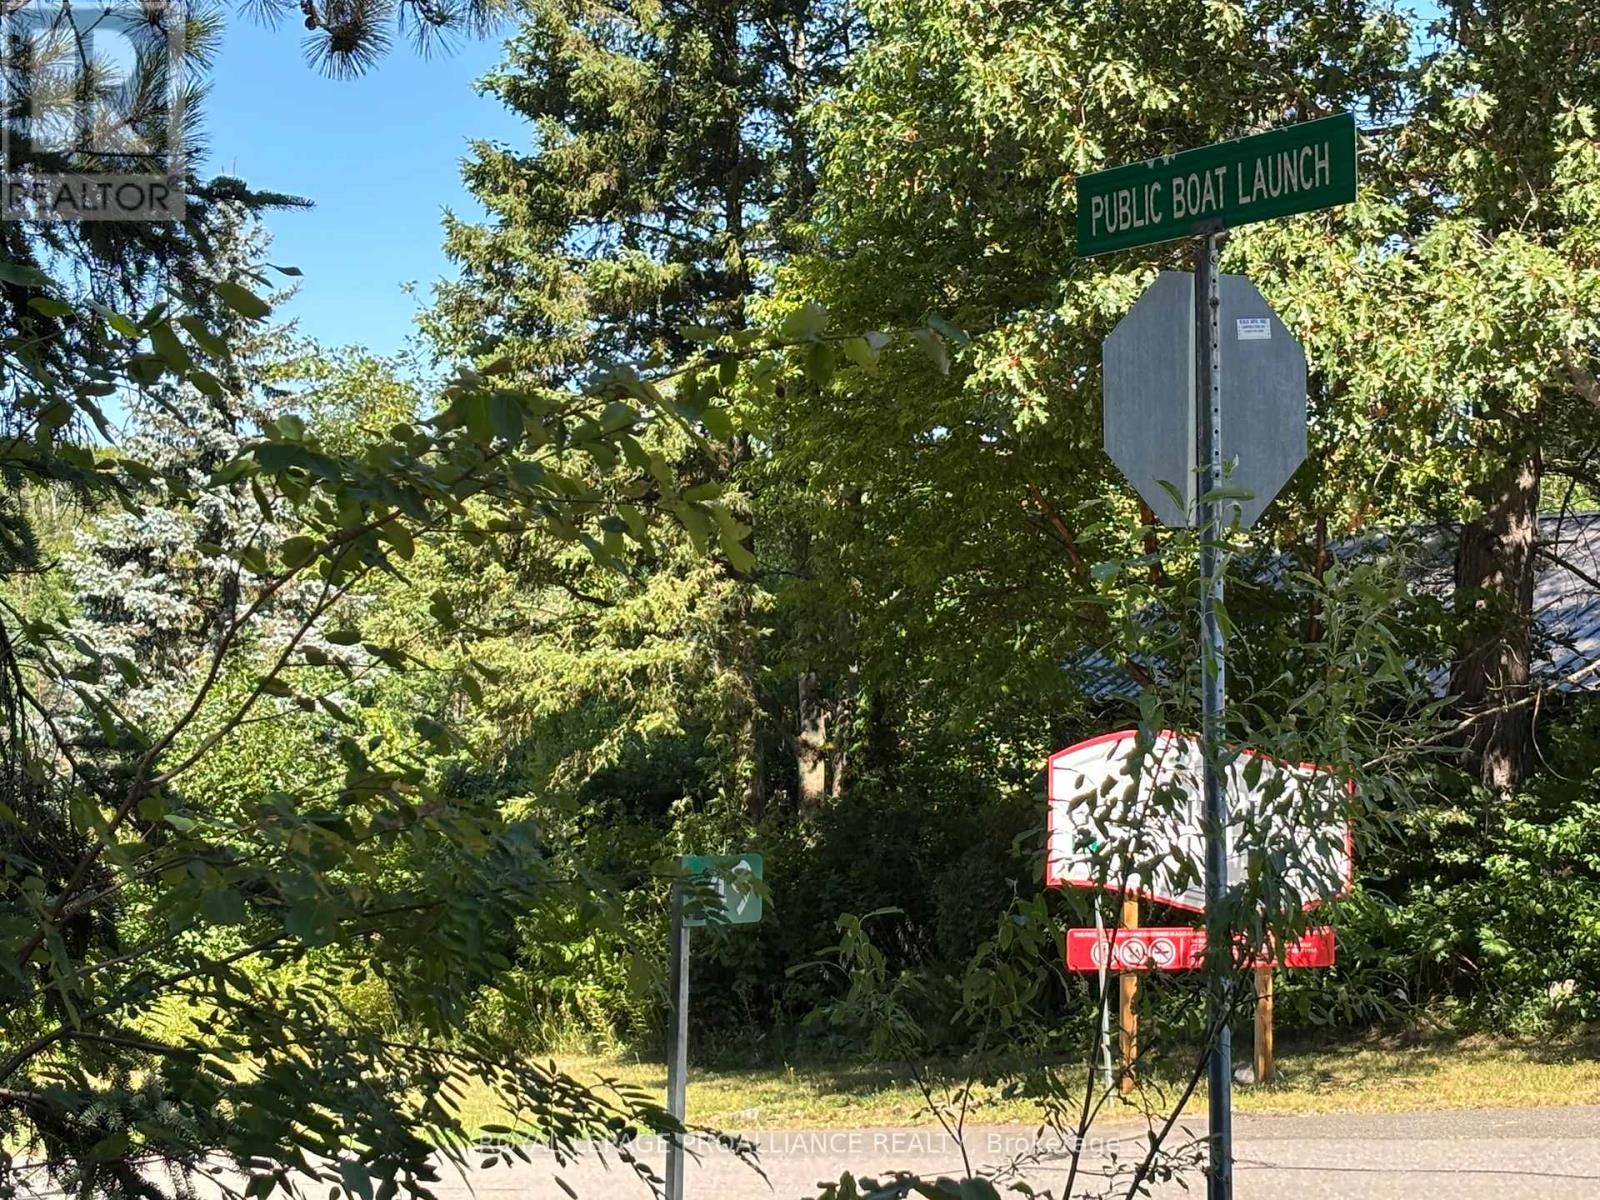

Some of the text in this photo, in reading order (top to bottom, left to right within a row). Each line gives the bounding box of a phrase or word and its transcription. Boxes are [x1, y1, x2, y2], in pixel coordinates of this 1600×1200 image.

[1091, 142, 1330, 237] PUBLIC BOAT LAUNCH
